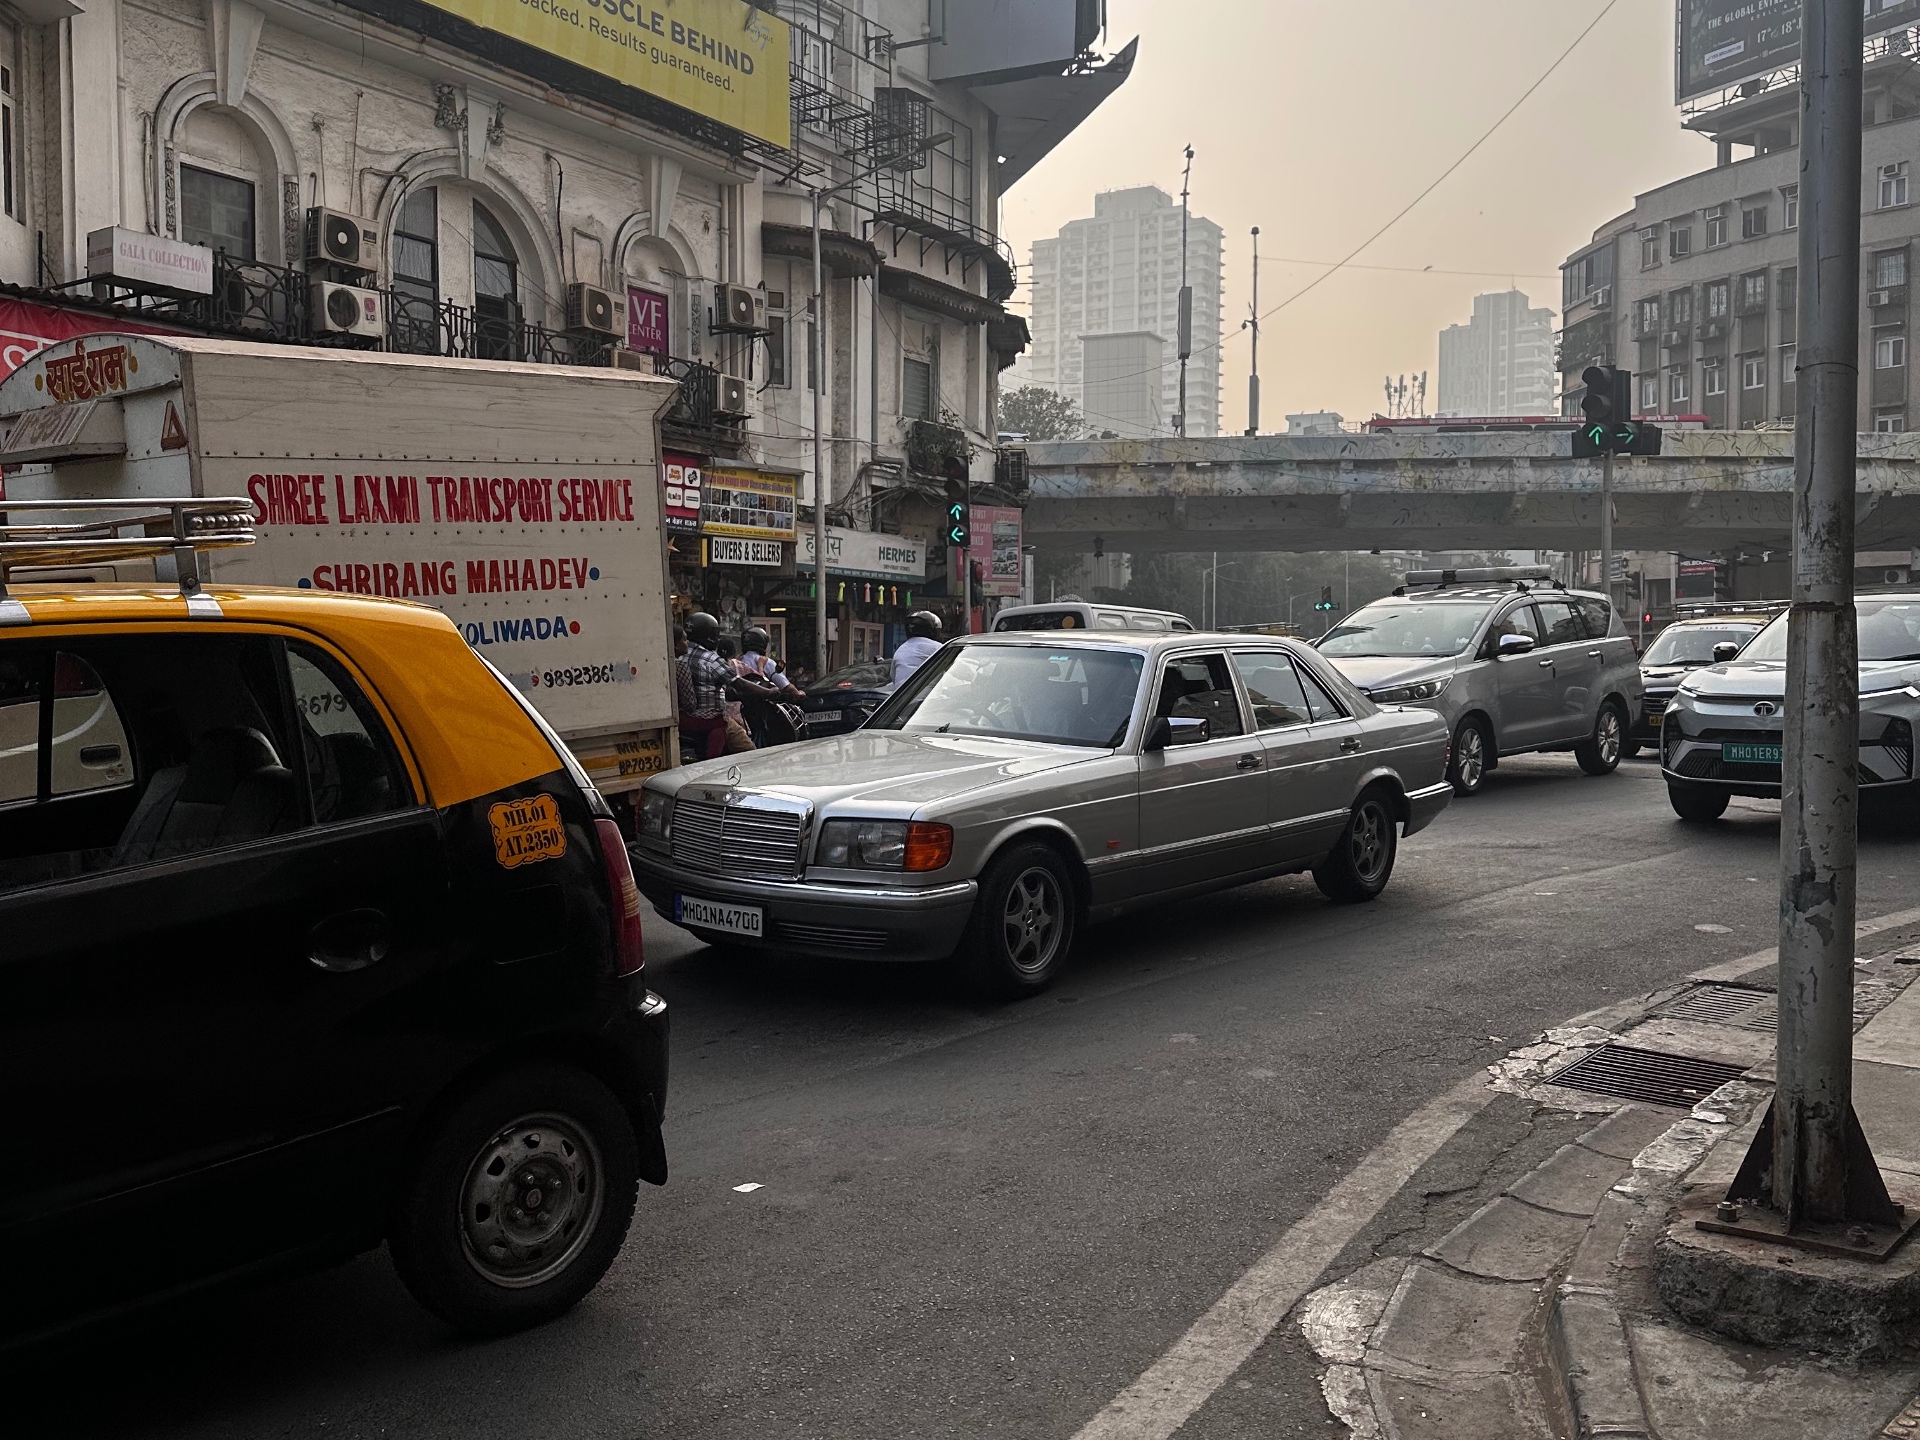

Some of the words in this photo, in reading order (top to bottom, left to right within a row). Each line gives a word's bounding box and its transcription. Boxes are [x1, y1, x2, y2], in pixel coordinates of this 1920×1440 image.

[1708, 16, 1722, 29] THE
[1725, 4, 1755, 23] GLOBAL
[522, 0, 584, 28] acked.
[589, 15, 647, 55] Results
[650, 46, 735, 93] guaranteed.
[580, 0, 664, 37] SCLE
[671, 20, 755, 75] BEHIND
[120, 242, 145, 260] GALA
[149, 248, 207, 273] COLLECTION
[248, 474, 329, 525] SHREE
[335, 475, 420, 524] LAXMI
[426, 477, 552, 523] TRANSPORT
[558, 479, 634, 521] SERVICE
[714, 540, 742, 560] BUYERS
[745, 542, 750, 561] &
[752, 542, 780, 563] SELLERS
[879, 546, 916, 563] HERMES
[313, 561, 457, 598] SHRIRANG
[466, 558, 588, 593] MAHADEV
[458, 616, 568, 645] OLIWADA
[1731, 746, 1783, 760] MH01ER9
[682, 900, 759, 931] MH01NA4700
